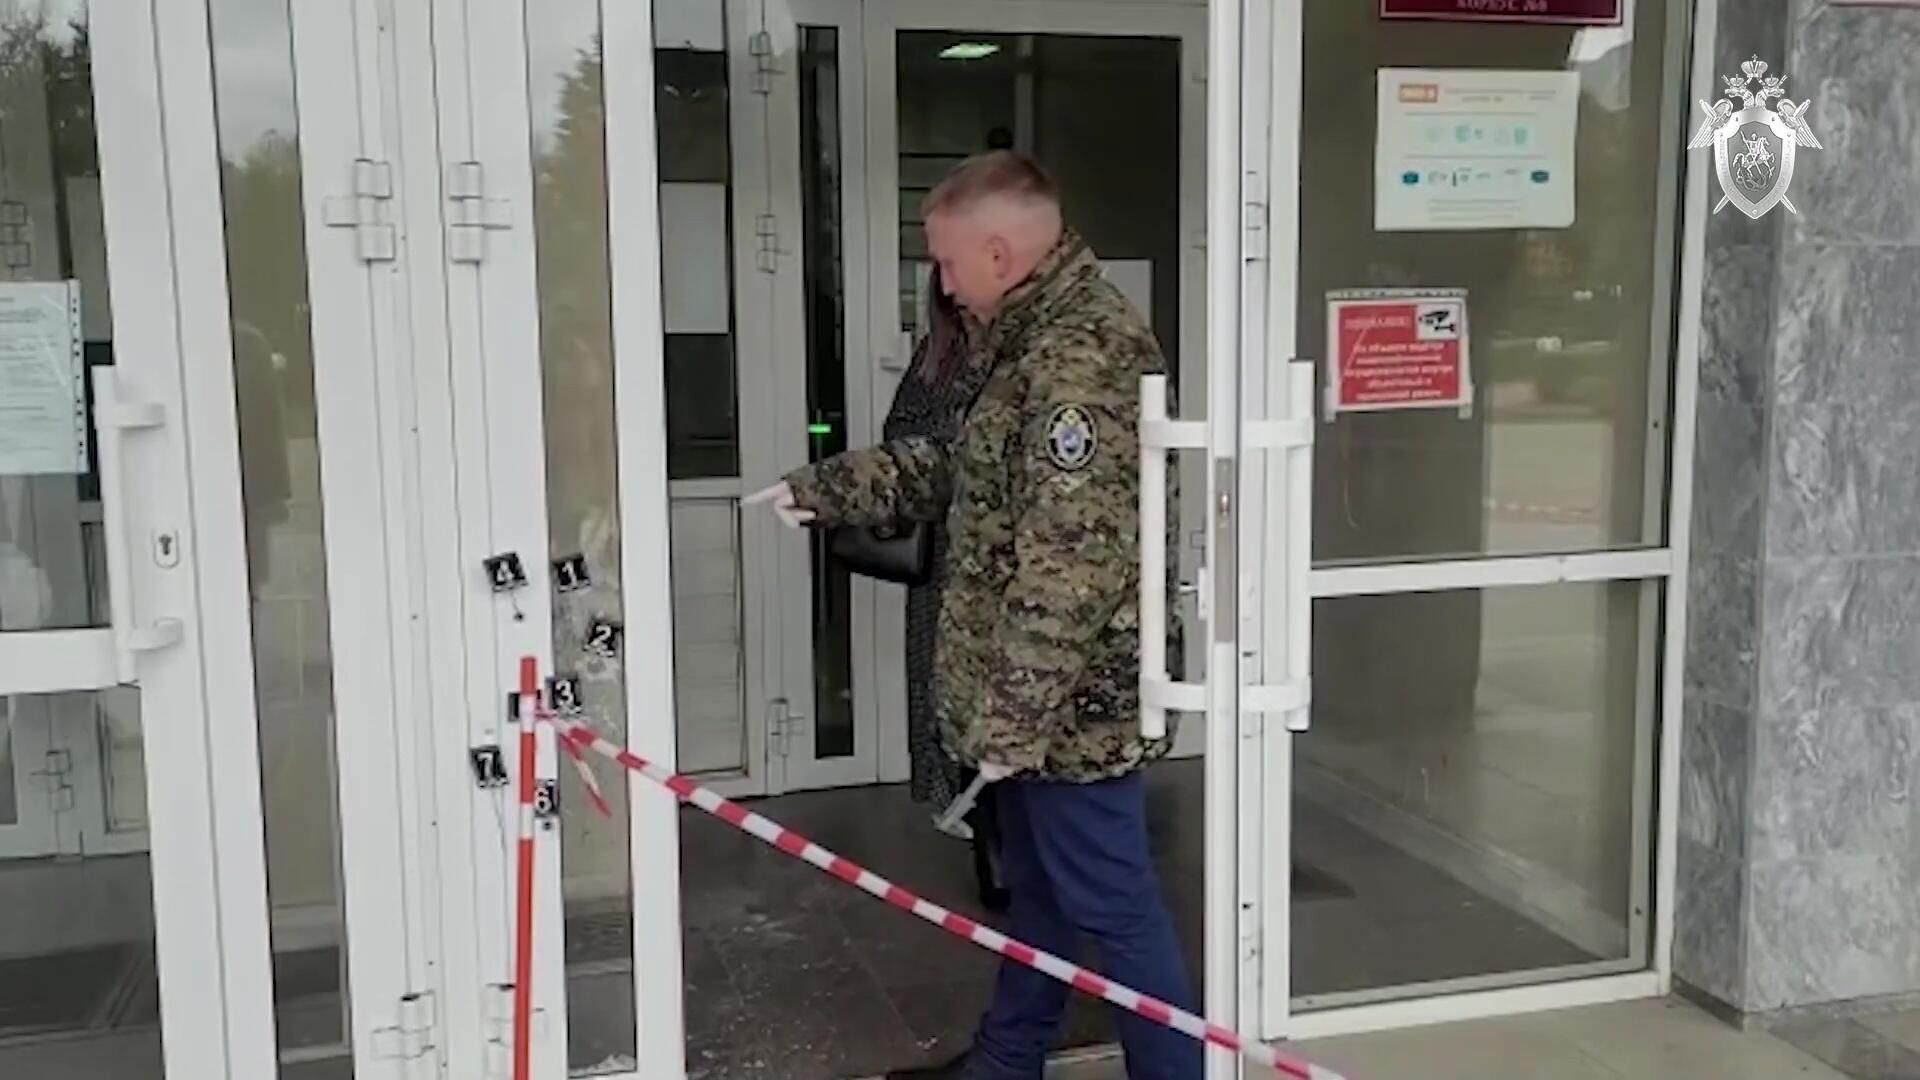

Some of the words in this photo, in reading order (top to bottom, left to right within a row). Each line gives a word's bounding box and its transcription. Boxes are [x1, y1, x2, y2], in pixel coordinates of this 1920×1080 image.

[496, 560, 514, 583] 4
[562, 560, 578, 587] 1
[588, 625, 611, 650] 2
[555, 680, 573, 708] 3
[477, 752, 494, 781] 7
[535, 786, 551, 815] 6
